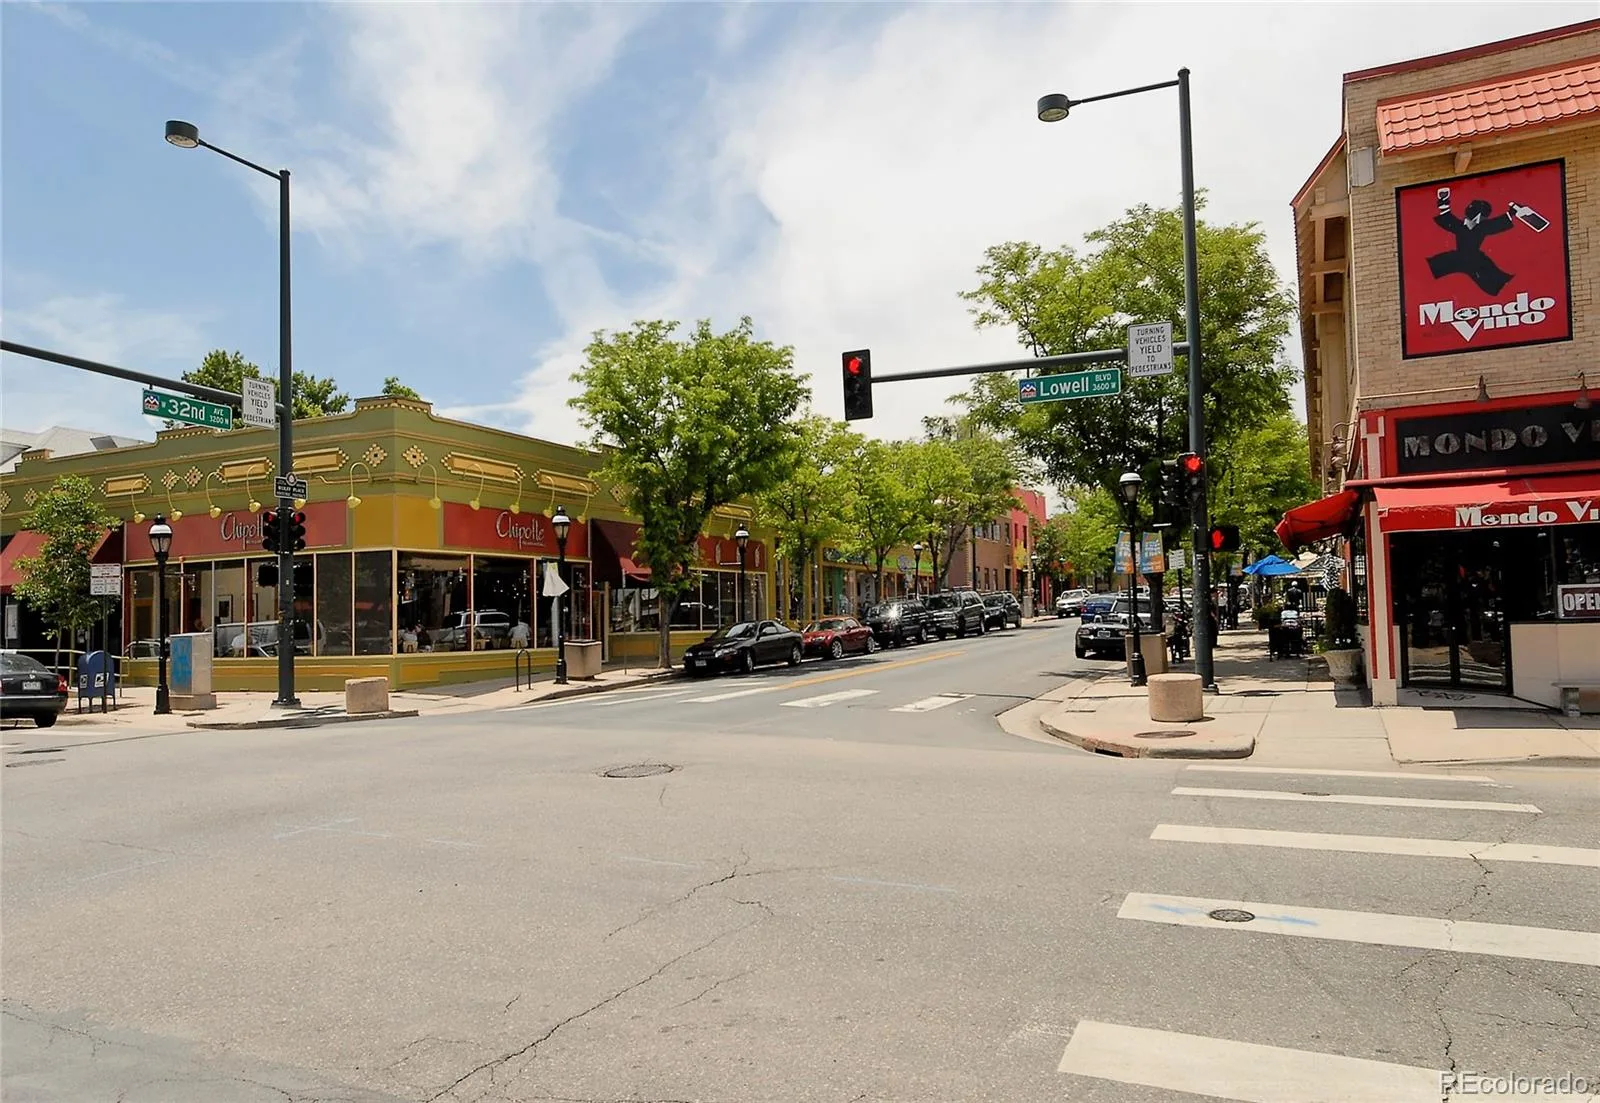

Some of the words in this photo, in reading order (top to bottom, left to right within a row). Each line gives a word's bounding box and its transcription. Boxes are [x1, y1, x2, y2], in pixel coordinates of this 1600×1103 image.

[1419, 292, 1555, 326] Mondo
[1136, 326, 1165, 336] TURNING
[1451, 311, 1546, 342] Vino
[1135, 334, 1167, 345] VEHICLES
[1140, 344, 1162, 354] YIELD
[1131, 362, 1171, 373] PEDESTRIANS
[248, 381, 269, 393] TURNING
[1040, 376, 1089, 397] Lowell
[1095, 373, 1112, 382] BLVD
[1092, 382, 1110, 391] 3600
[247, 389, 271, 400] VEHICLES
[168, 398, 206, 421] 32nd
[213, 407, 225, 417] AVE
[251, 399, 269, 409] YIELD
[256, 408, 263, 416] TO
[243, 413, 275, 426] PEDESTRIANS
[1404, 424, 1548, 458] MONDO
[1455, 505, 1558, 526] Mondo
[221, 512, 265, 550] Chipotl
[496, 511, 545, 550] Chipotle
